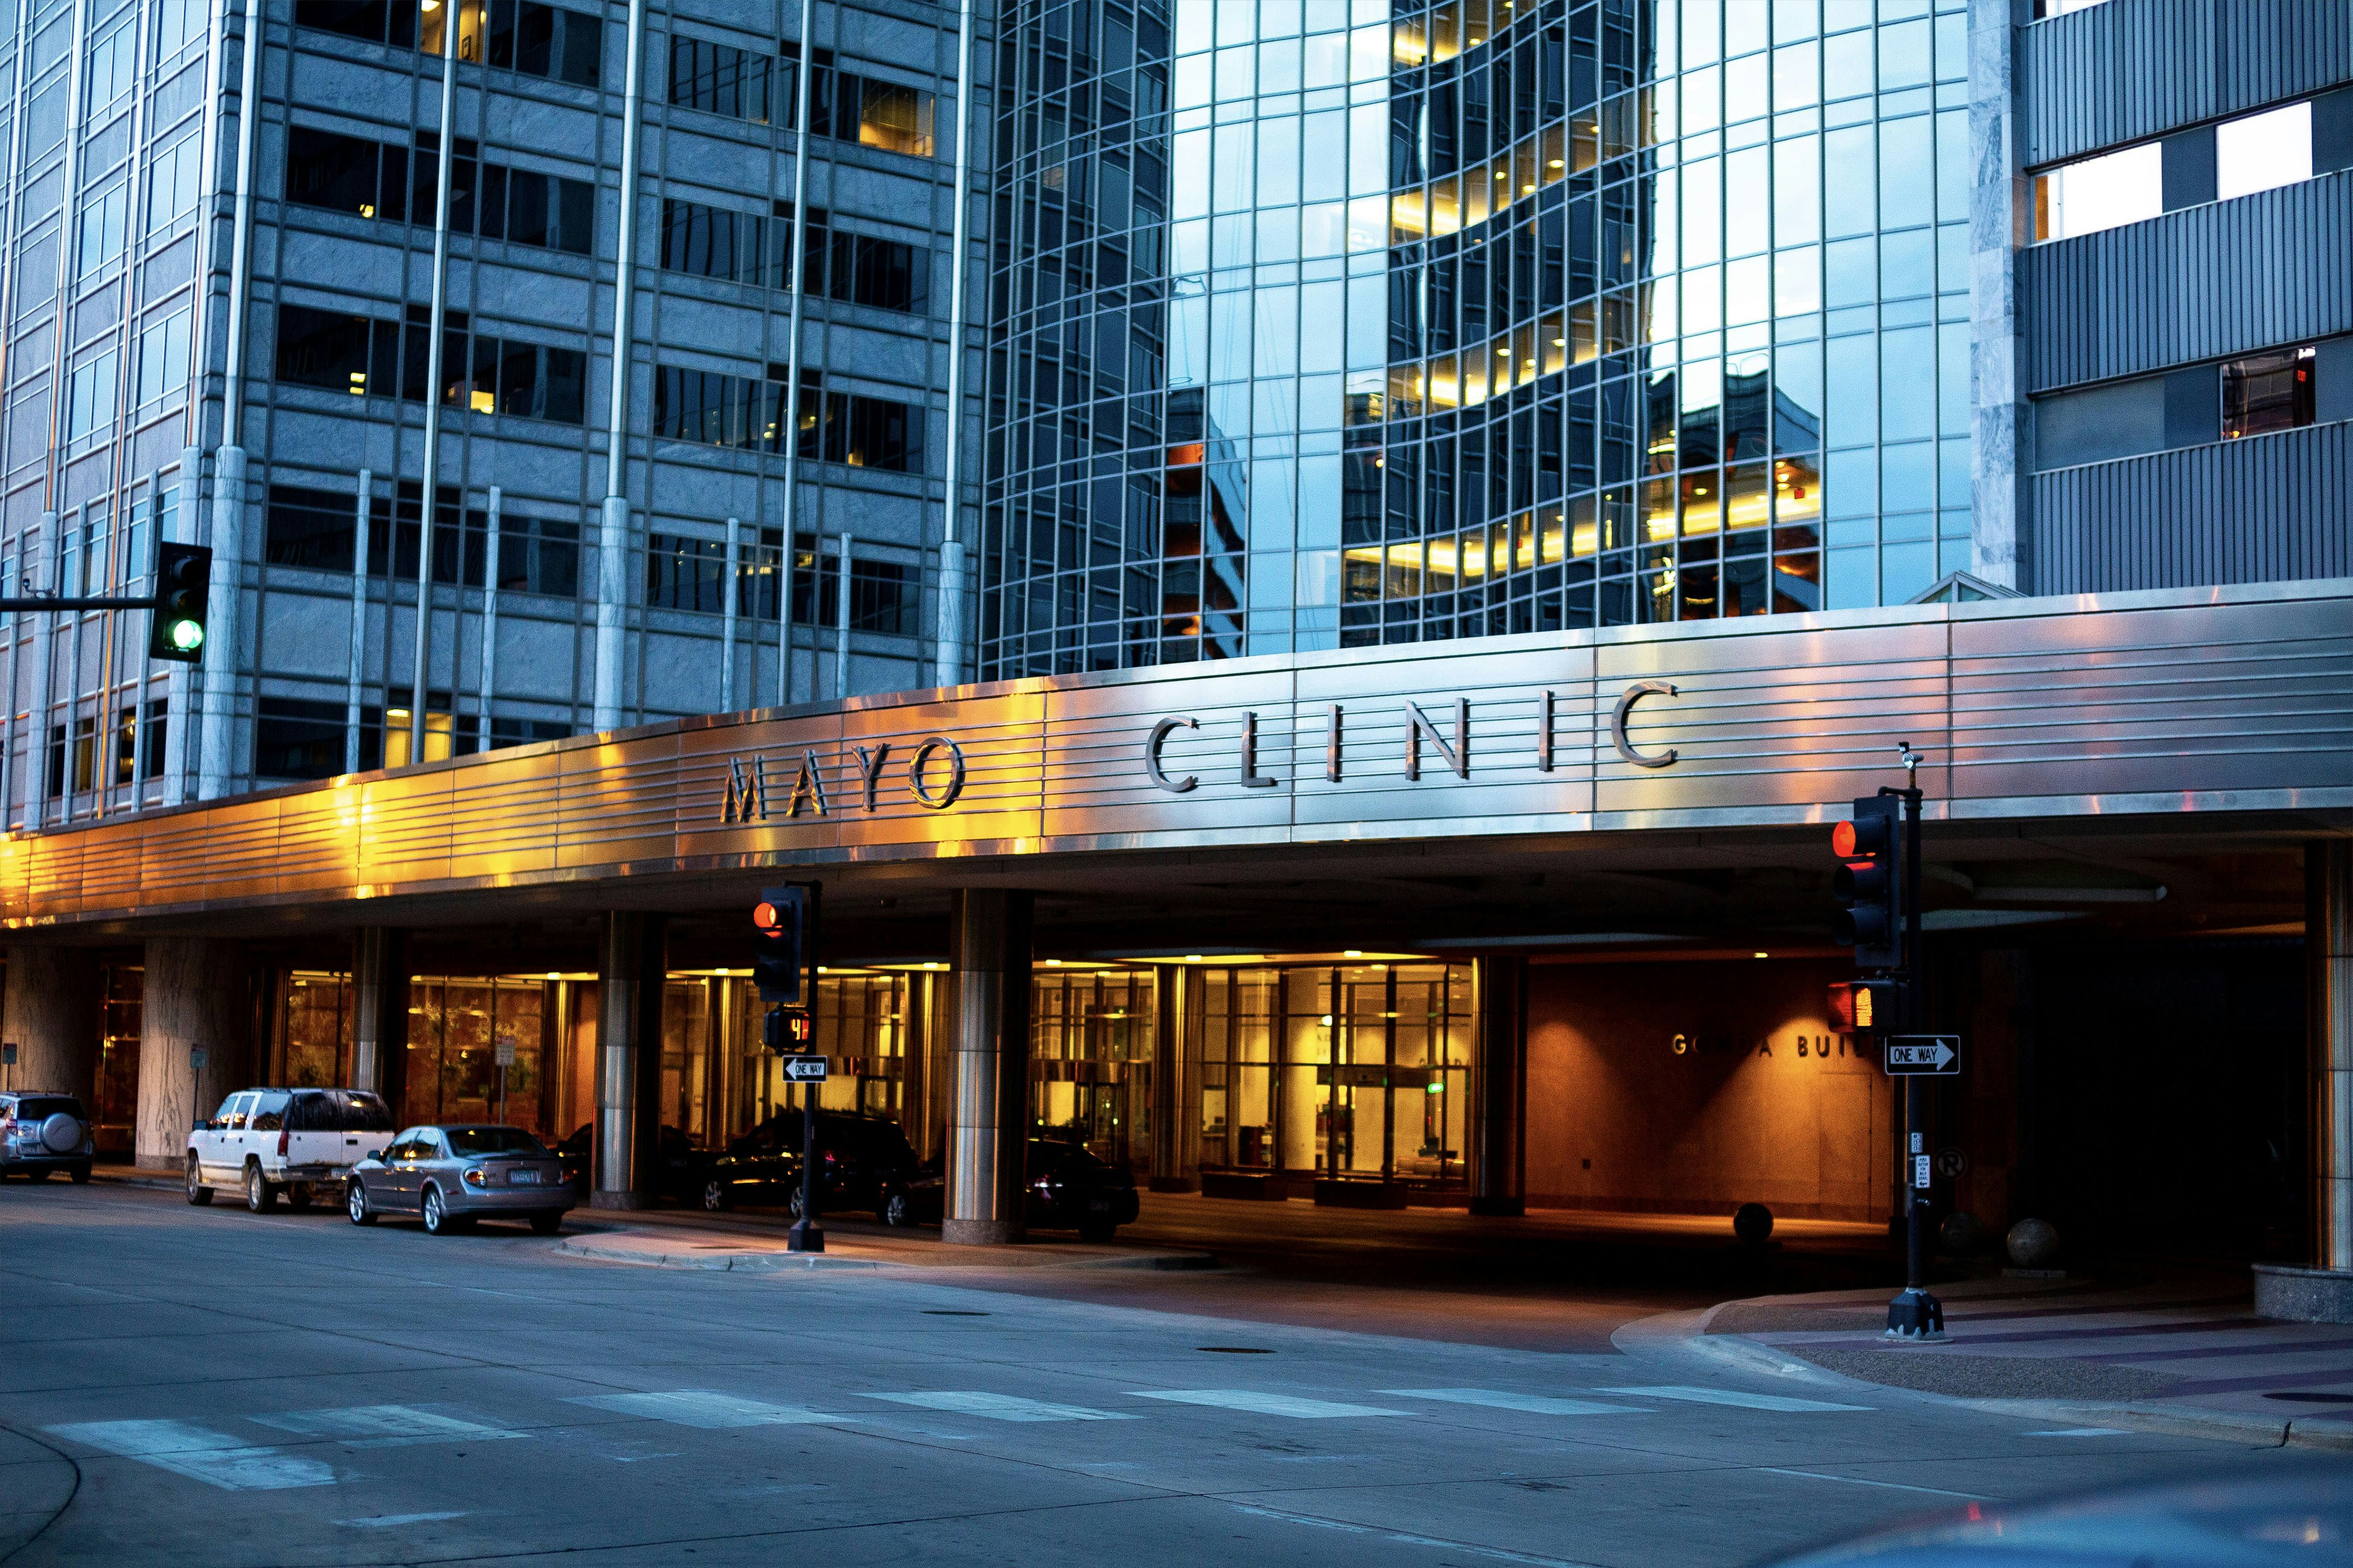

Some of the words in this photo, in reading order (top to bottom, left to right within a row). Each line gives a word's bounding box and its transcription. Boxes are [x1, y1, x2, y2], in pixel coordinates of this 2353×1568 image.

[719, 736, 964, 824] MAYO
[1145, 680, 1678, 794] CLINIC
[1894, 1048, 1912, 1062] ONE
[1918, 1048, 1937, 1062] WAY
[795, 1064, 806, 1074] ONE
[809, 1064, 822, 1073] WAY
